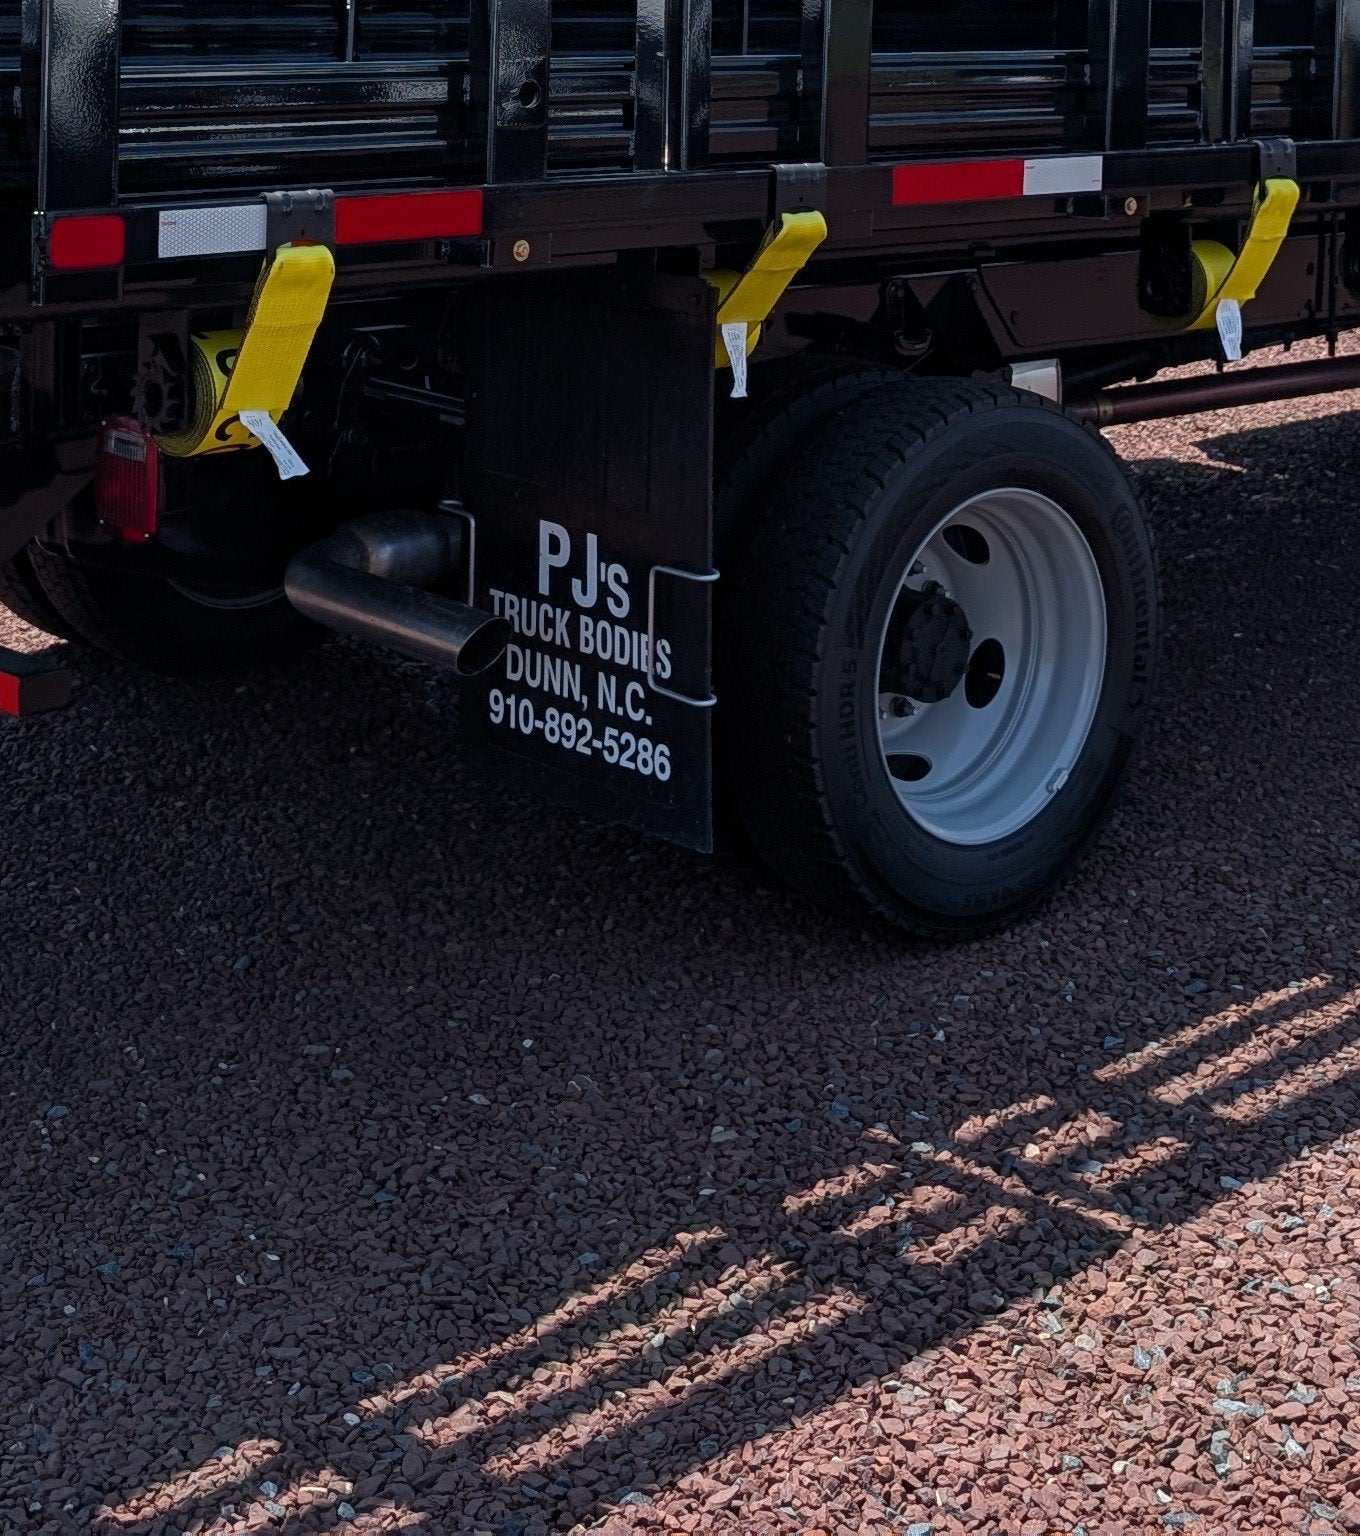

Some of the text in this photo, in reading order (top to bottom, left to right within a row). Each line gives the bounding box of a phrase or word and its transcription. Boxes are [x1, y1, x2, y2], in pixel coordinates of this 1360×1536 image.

[489, 588, 672, 680] TRUCK BODIES
[506, 644, 653, 726] DUNN, N.C.
[488, 688, 671, 782] 910-892-5286
